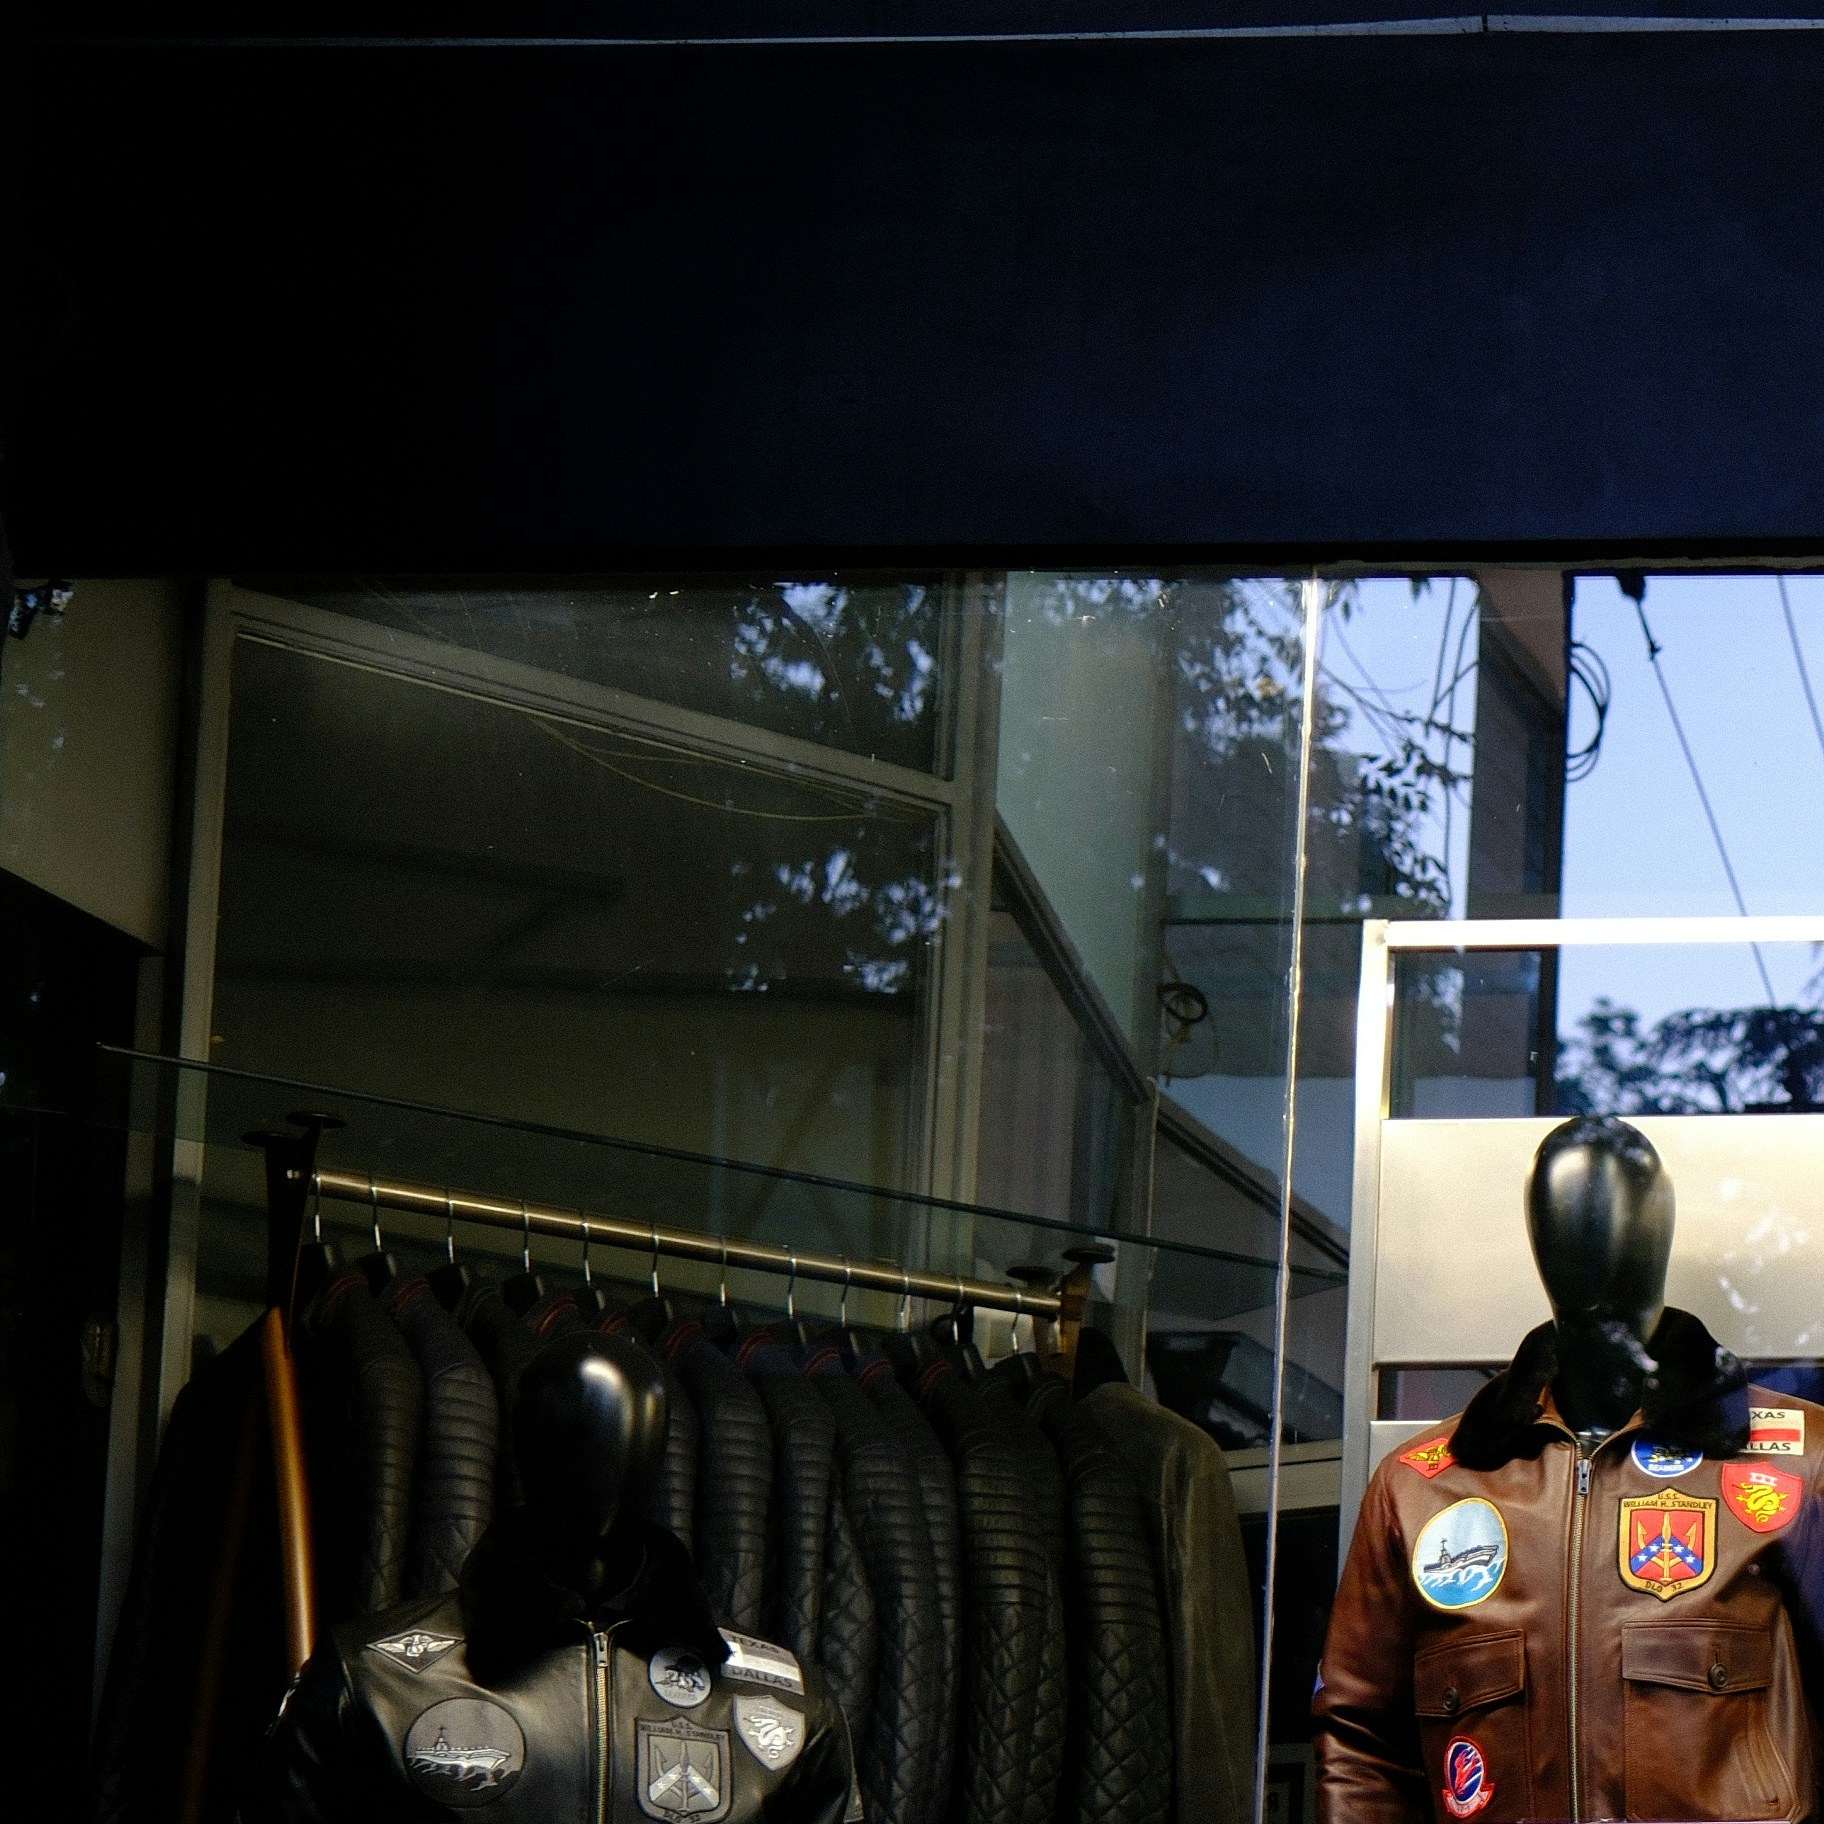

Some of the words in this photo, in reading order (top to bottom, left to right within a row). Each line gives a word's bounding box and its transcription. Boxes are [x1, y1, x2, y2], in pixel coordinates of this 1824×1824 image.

[1752, 1411, 1786, 1419] XAS
[1671, 1501, 1713, 1510] STANDLEY
[732, 1668, 793, 1687] DALLAS
